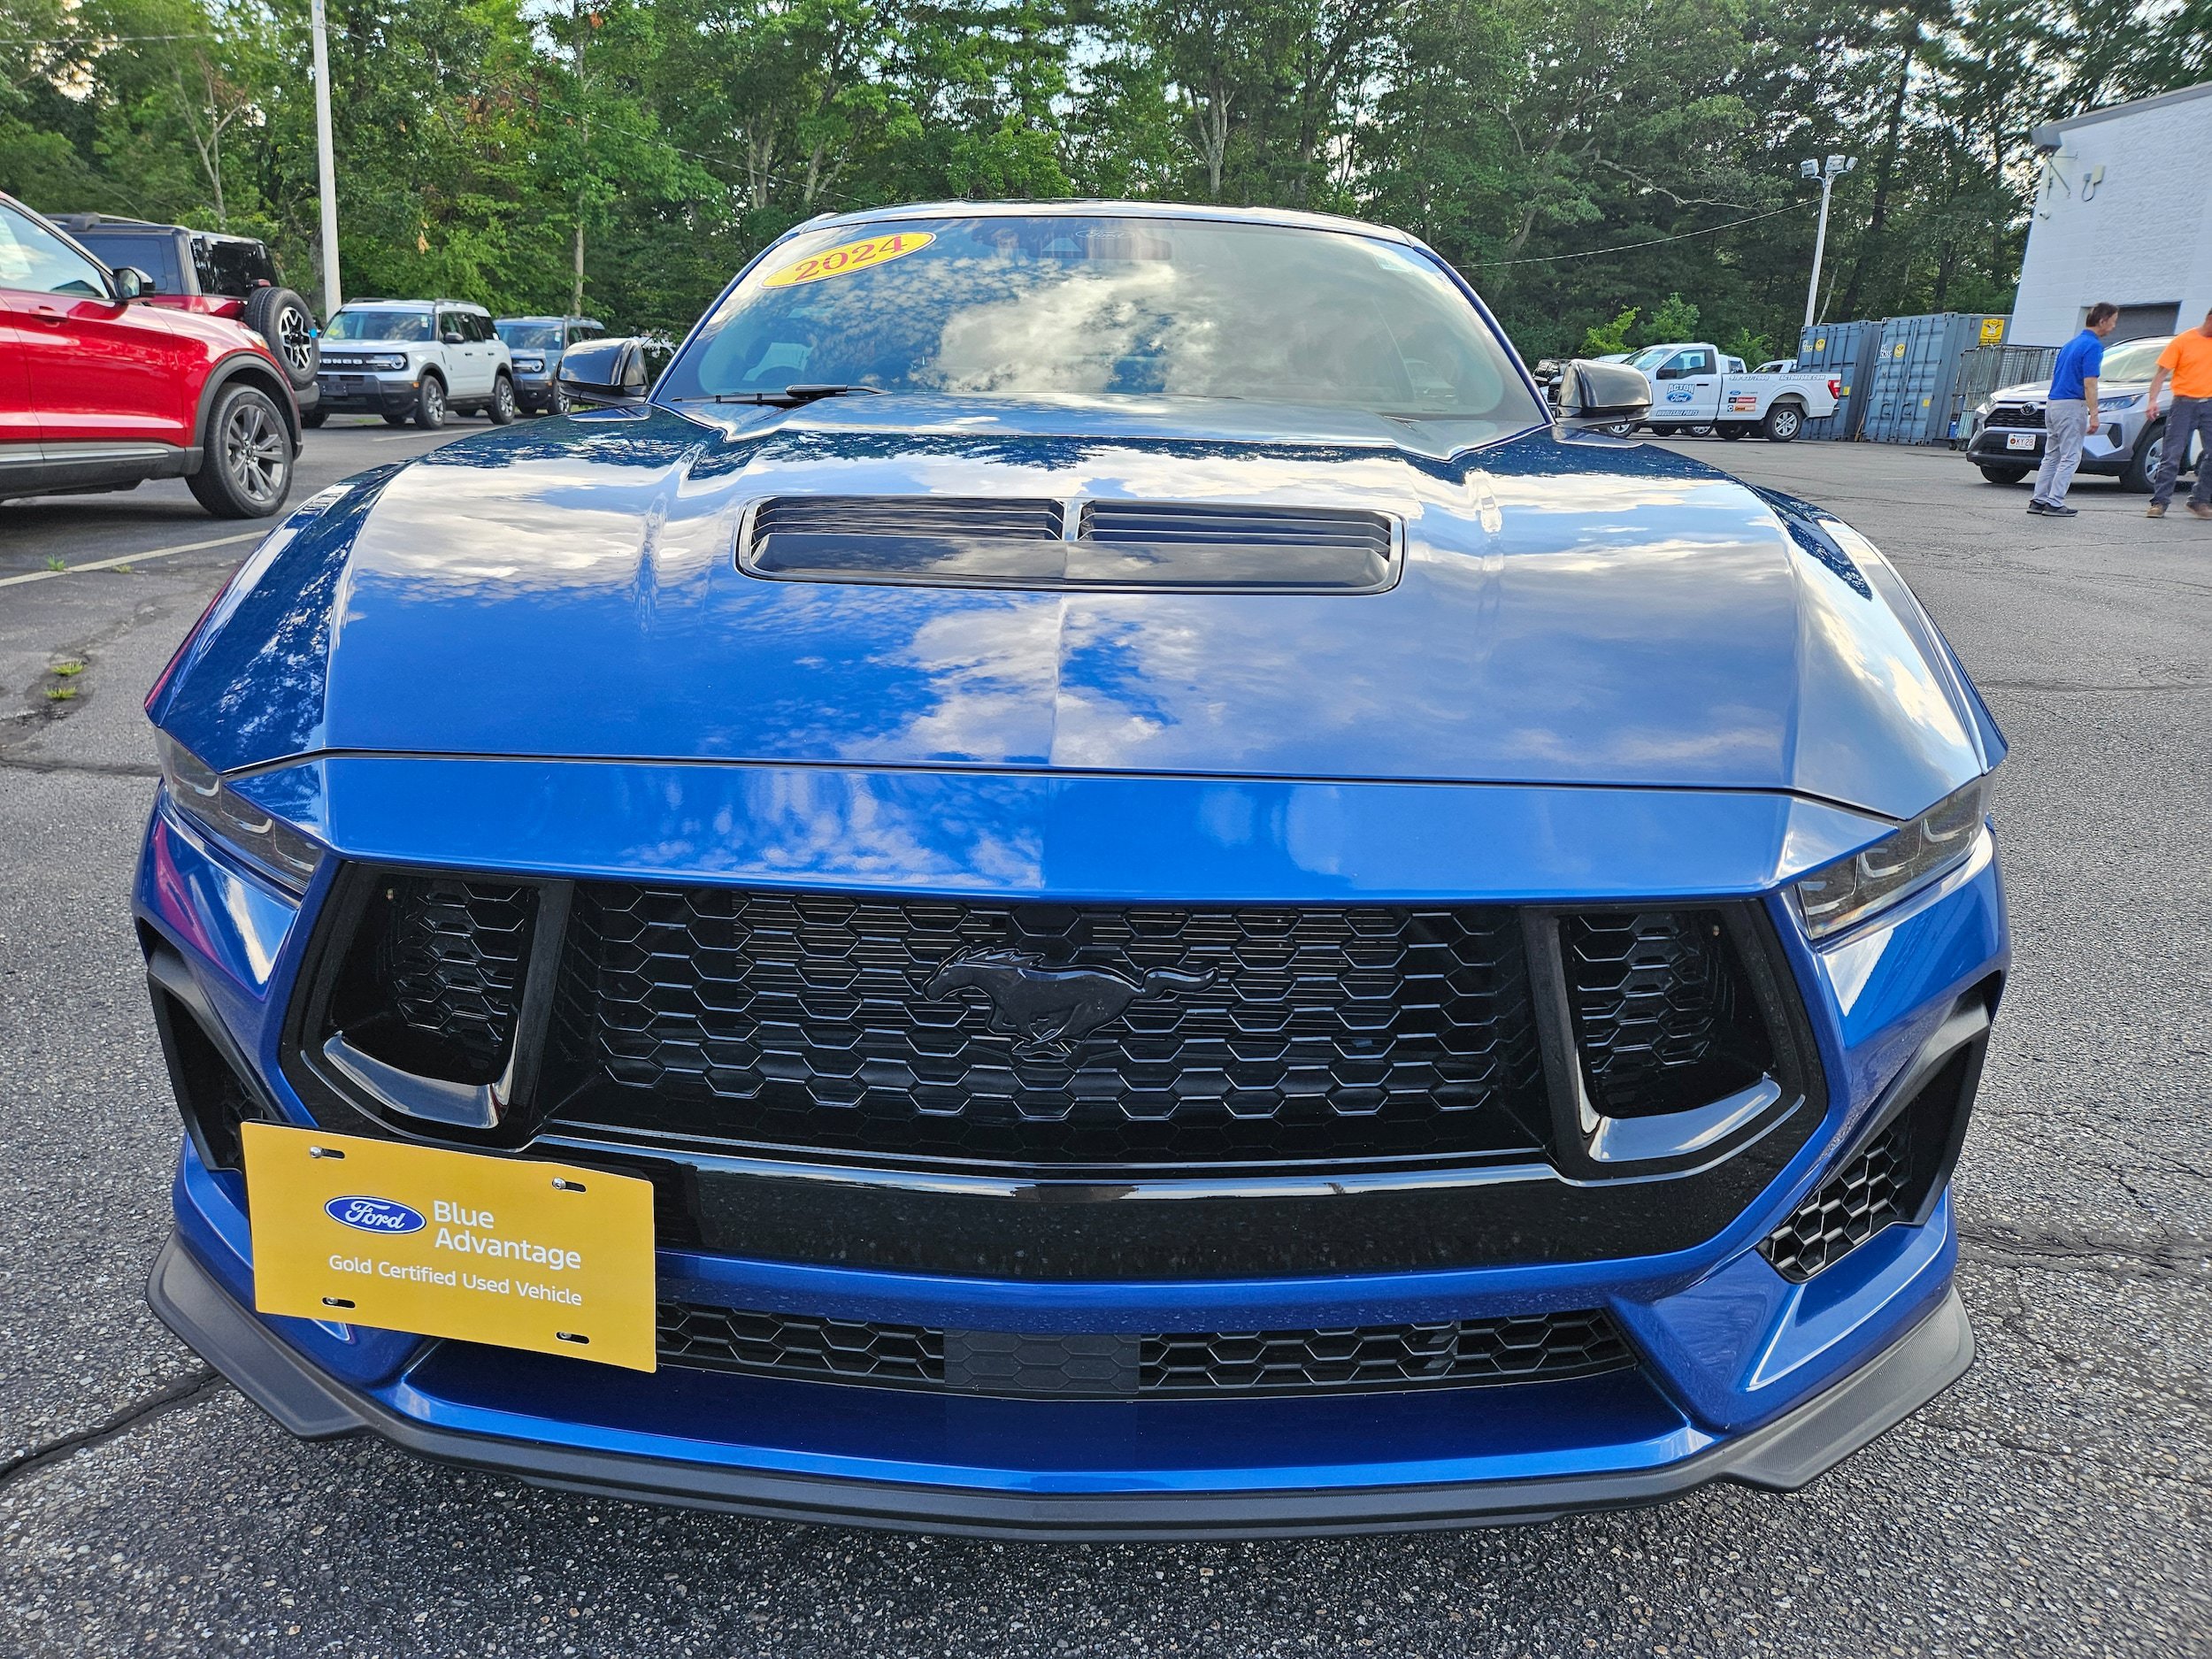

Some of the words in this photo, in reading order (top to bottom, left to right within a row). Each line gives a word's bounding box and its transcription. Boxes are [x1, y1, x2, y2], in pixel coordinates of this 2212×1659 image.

[795, 236, 908, 281] 2024
[1667, 383, 1695, 395] ACTON
[344, 1200, 406, 1230] Ford
[434, 1200, 495, 1229] Blue
[434, 1227, 581, 1270] Advantage
[329, 1255, 373, 1276] Gold
[379, 1261, 457, 1287] Certified
[463, 1274, 511, 1294] Used
[516, 1281, 582, 1306] Vehicle
